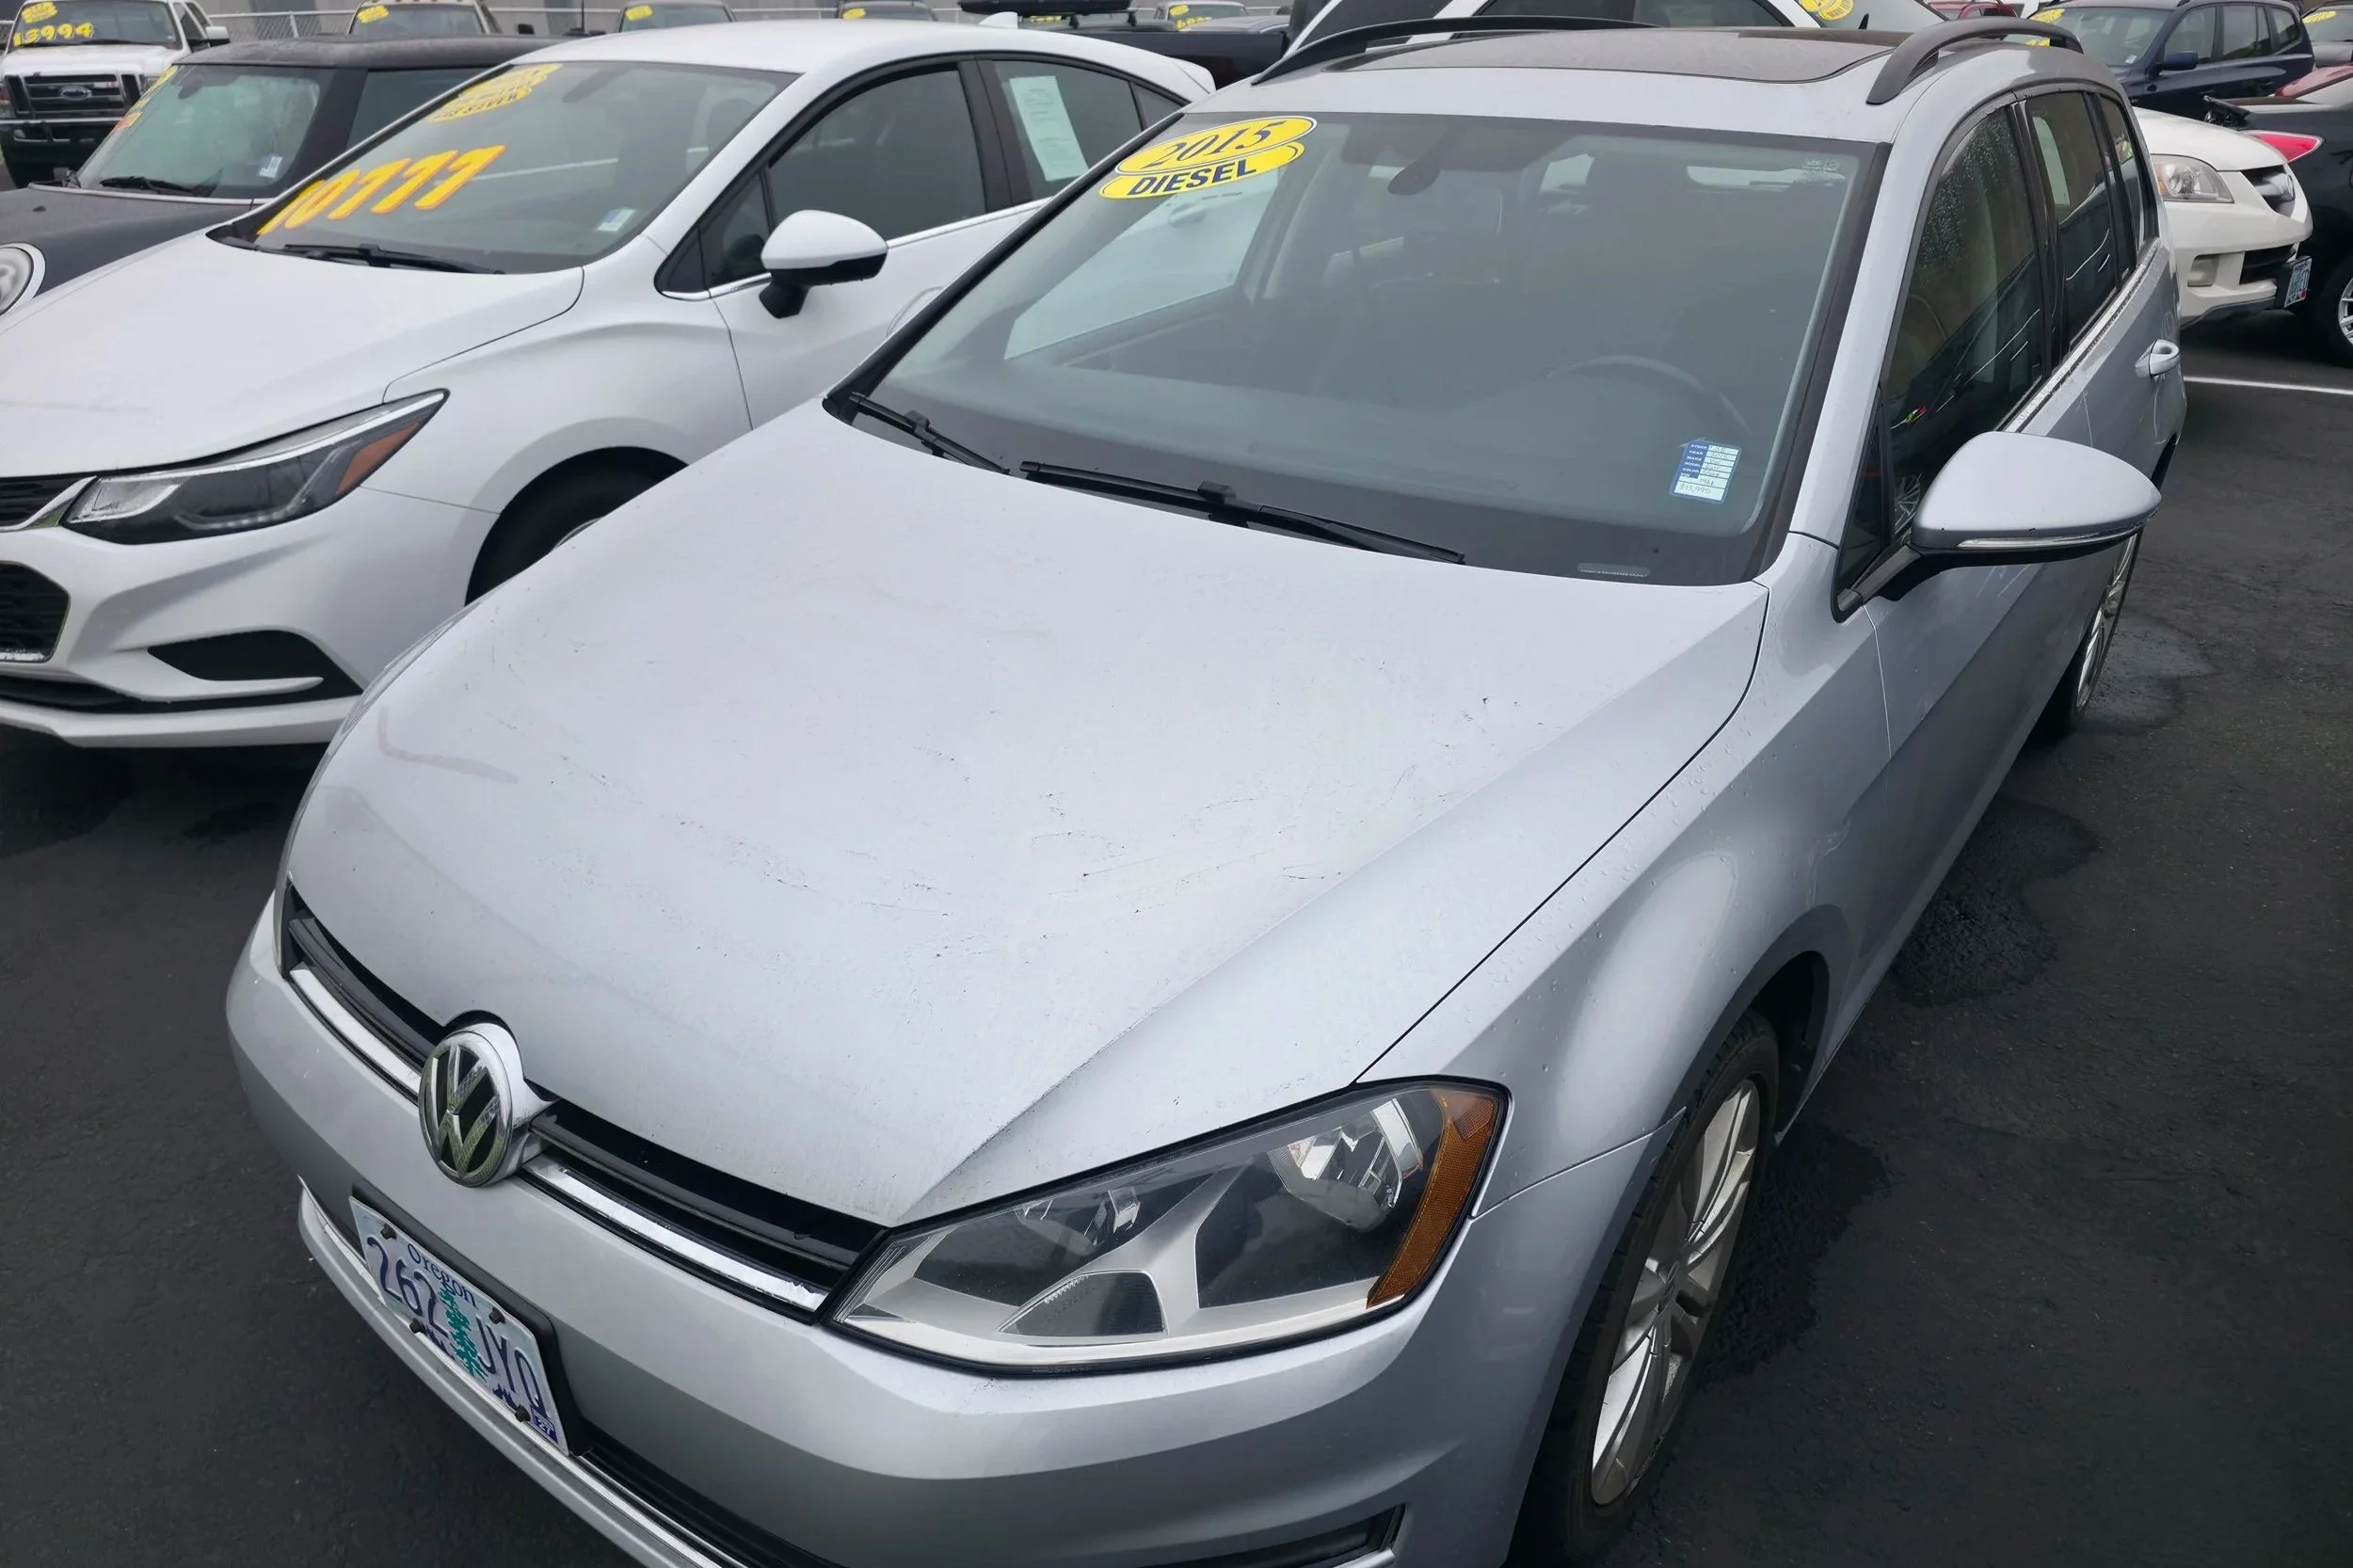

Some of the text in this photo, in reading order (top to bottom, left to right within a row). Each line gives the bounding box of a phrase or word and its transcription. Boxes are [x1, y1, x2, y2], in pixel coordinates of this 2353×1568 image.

[1128, 158, 1257, 196] DIESEL
[1141, 120, 1288, 170] 2015
[256, 145, 507, 235] 10777
[366, 1236, 450, 1339] 262
[407, 1242, 479, 1310] Oregon
